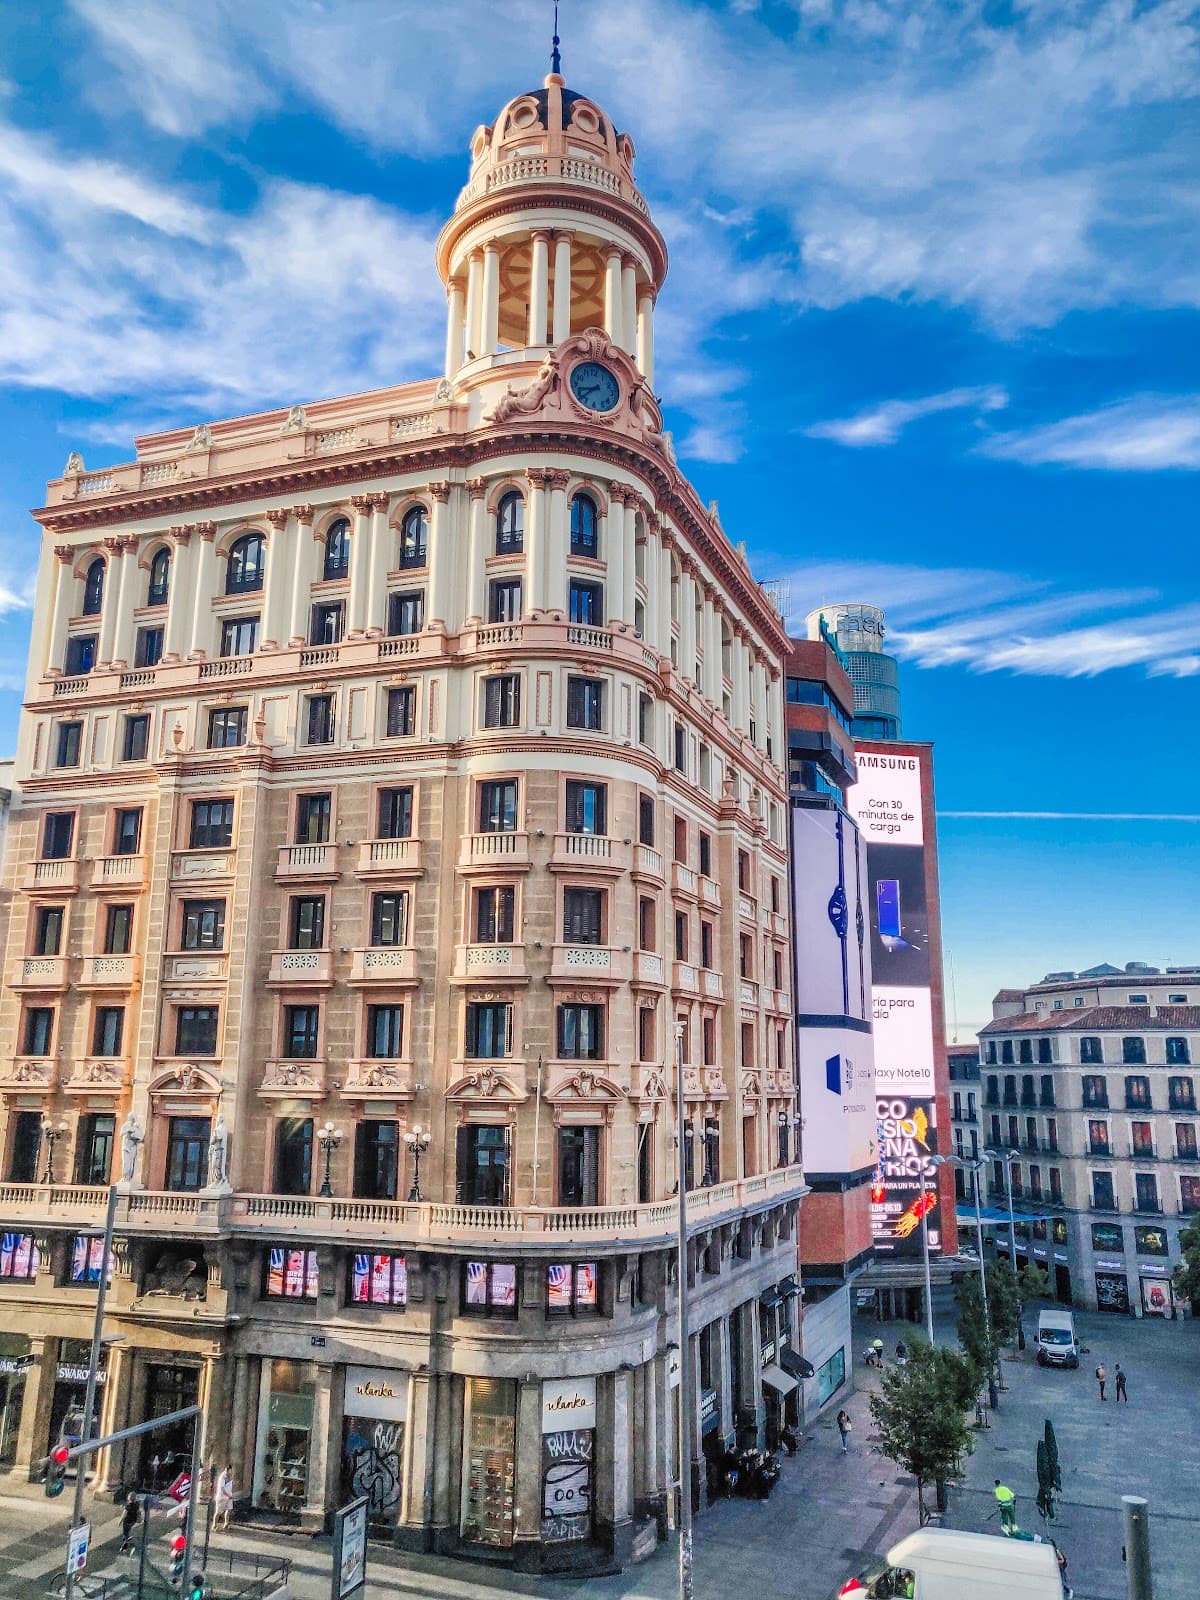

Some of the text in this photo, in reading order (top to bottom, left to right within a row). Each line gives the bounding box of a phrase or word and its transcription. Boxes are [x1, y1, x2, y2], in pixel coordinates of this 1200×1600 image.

[859, 756, 916, 771] AMSUNG
[868, 799, 903, 809] Con 30
[858, 809, 914, 821] minutos de
[870, 823, 901, 834] carga
[873, 997, 915, 1010] ría para
[875, 1068, 895, 1080] laxy
[897, 1068, 931, 1078] Note10
[876, 1100, 907, 1120] CO
[883, 1119, 918, 1139] SIO
[886, 1138, 919, 1157] NA
[909, 1181, 937, 1190] PLAETA
[356, 1381, 401, 1398] ulanka
[545, 1393, 595, 1411] ulanka
